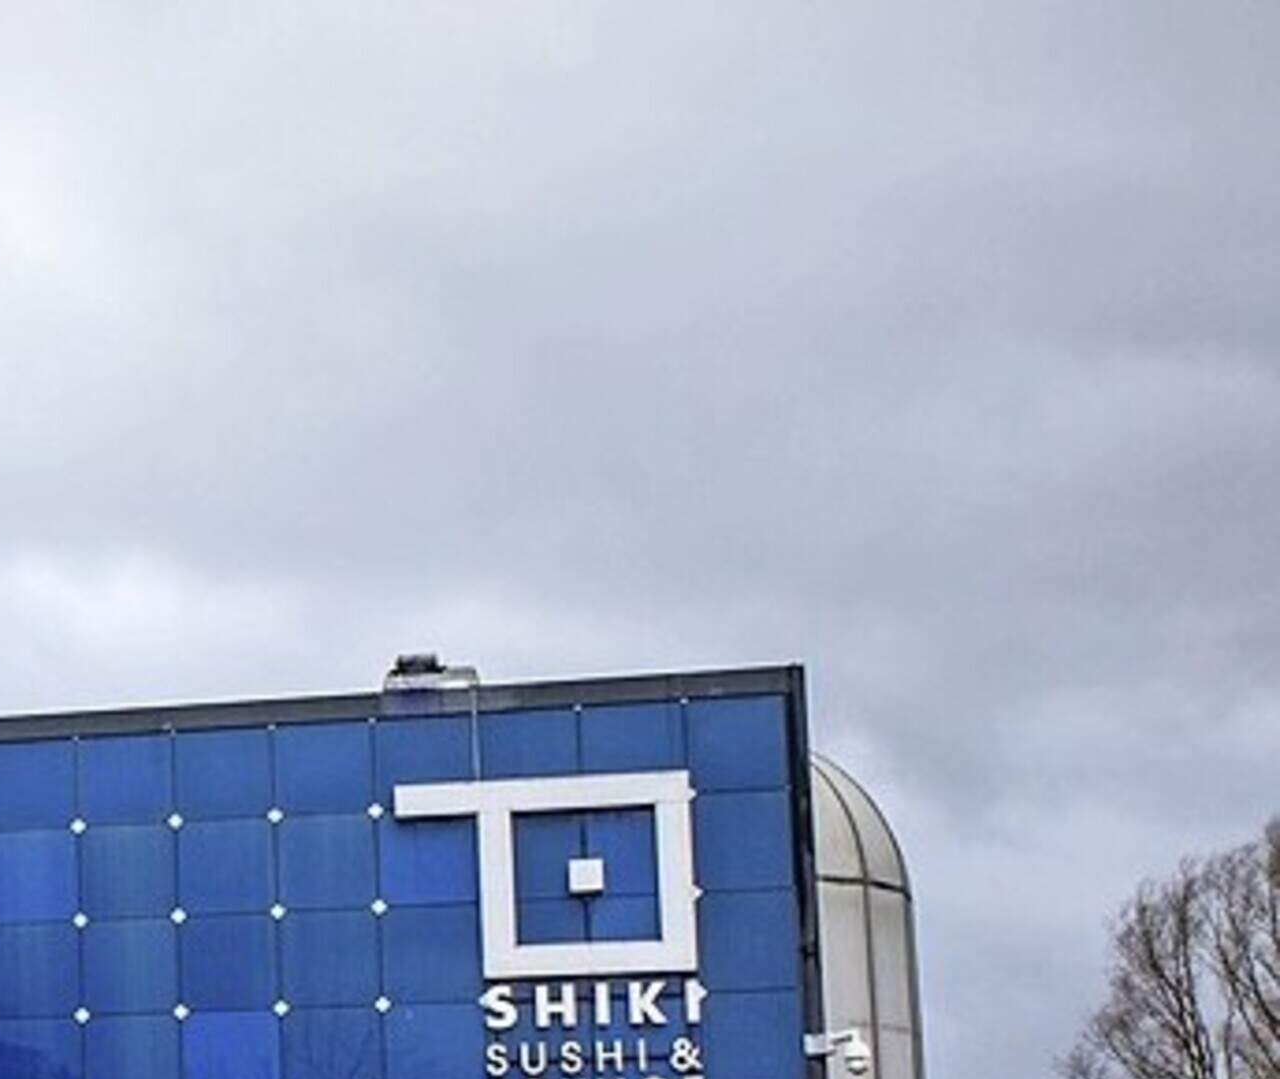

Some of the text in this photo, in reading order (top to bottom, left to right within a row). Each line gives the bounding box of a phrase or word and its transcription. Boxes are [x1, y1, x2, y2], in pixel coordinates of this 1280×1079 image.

[484, 978, 701, 1029] SHIKI
[486, 1036, 704, 1076] SUSHI &
